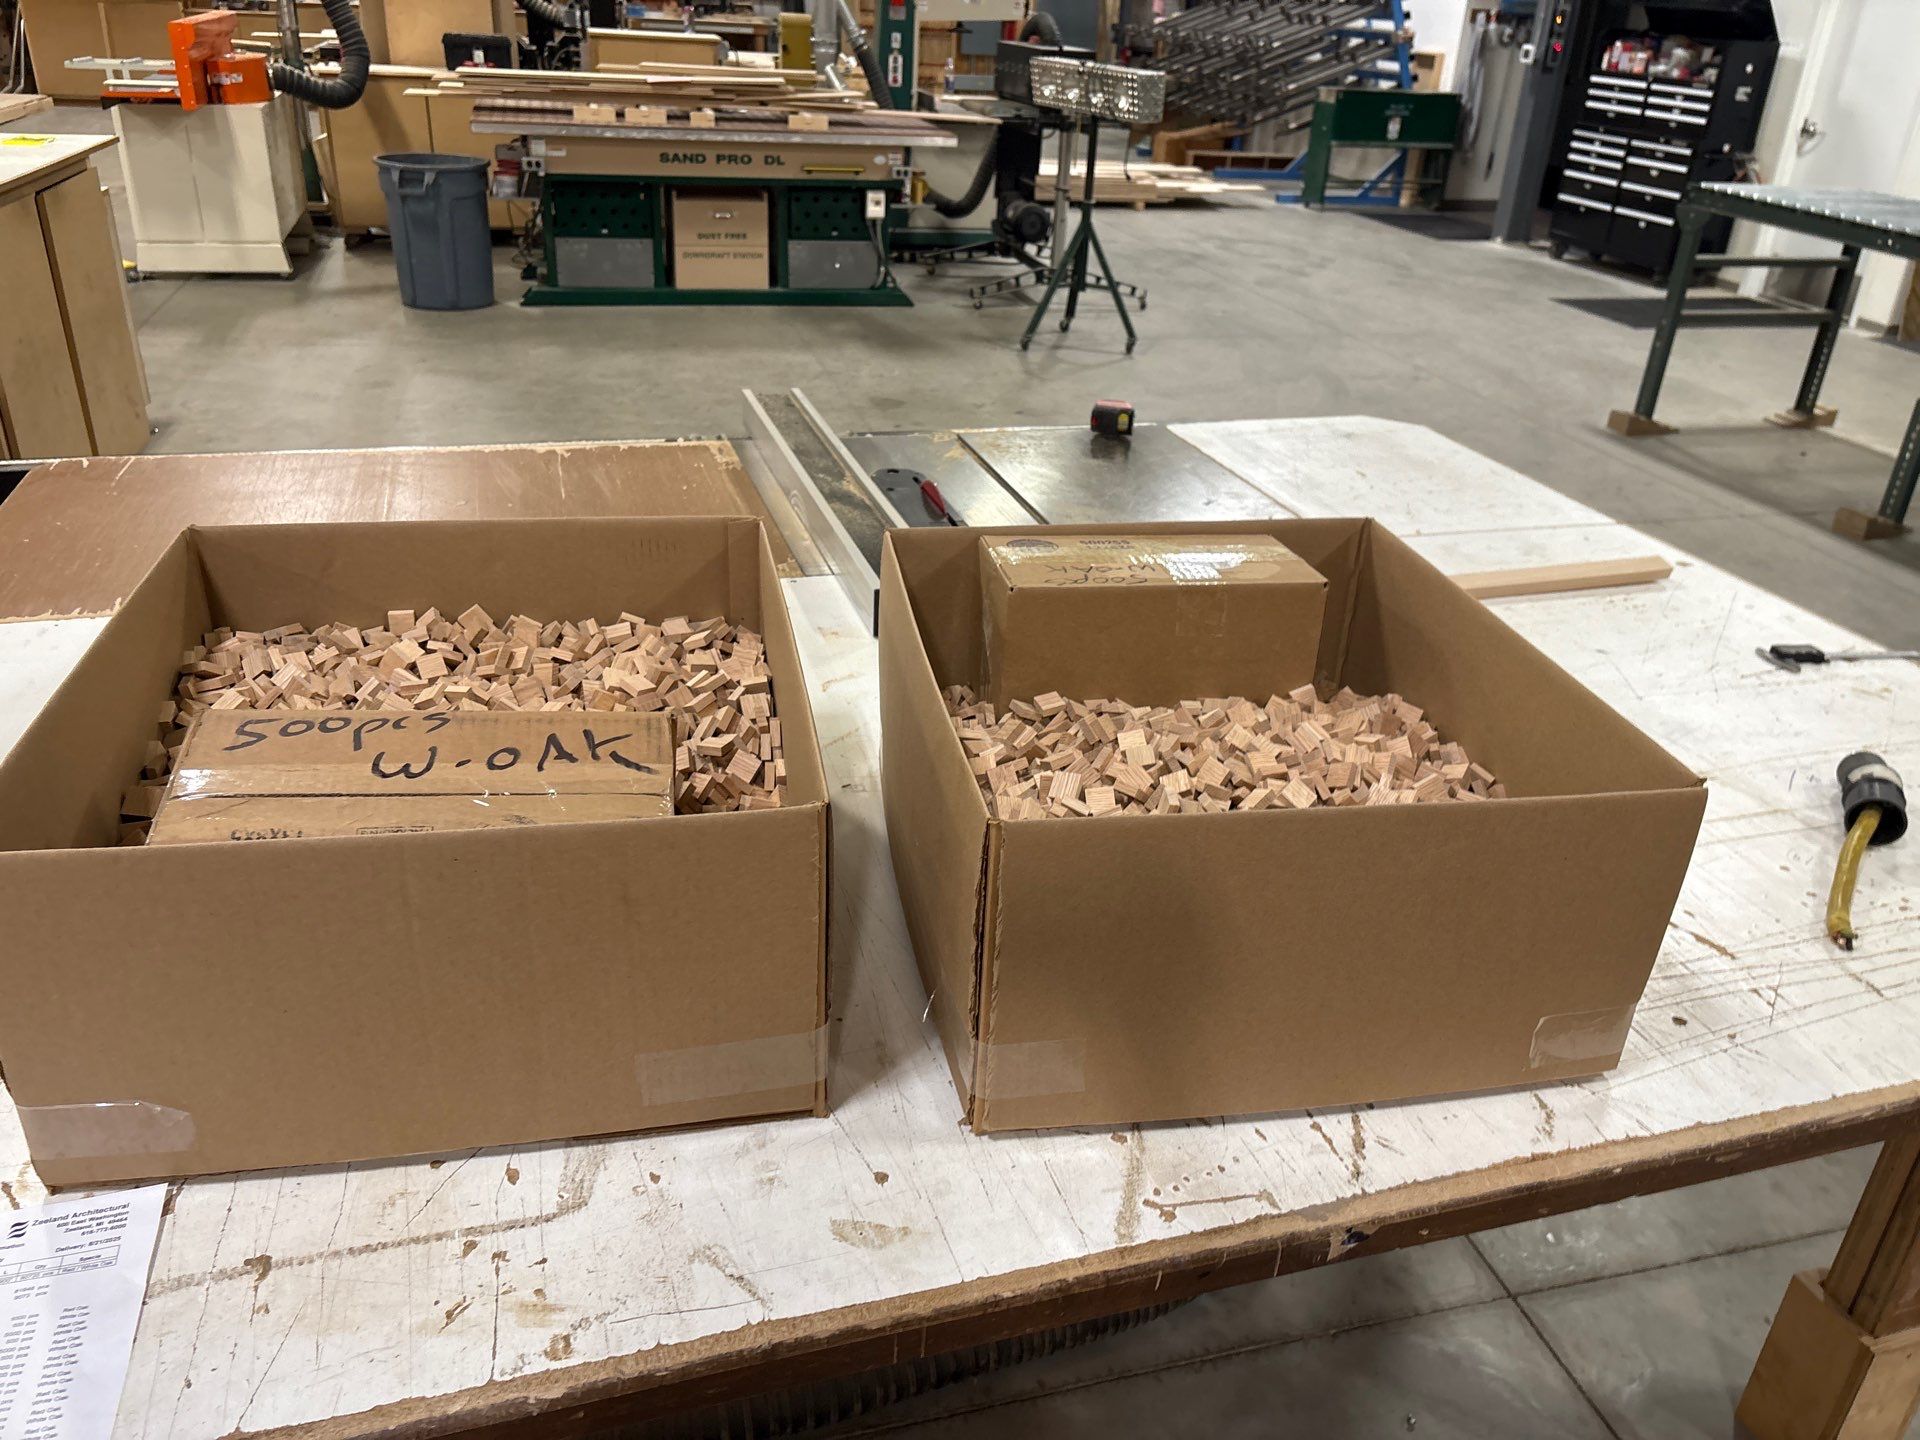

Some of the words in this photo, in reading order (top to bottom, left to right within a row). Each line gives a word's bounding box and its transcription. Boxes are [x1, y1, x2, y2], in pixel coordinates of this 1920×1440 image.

[659, 152, 707, 164] SAND
[716, 154, 752, 165] PRO
[764, 155, 785, 165] DL
[31, 1214, 70, 1226] Zeeland
[71, 1203, 130, 1218] Architectural
[88, 1211, 130, 1223] Washington
[55, 1244, 87, 1253] Delivery:
